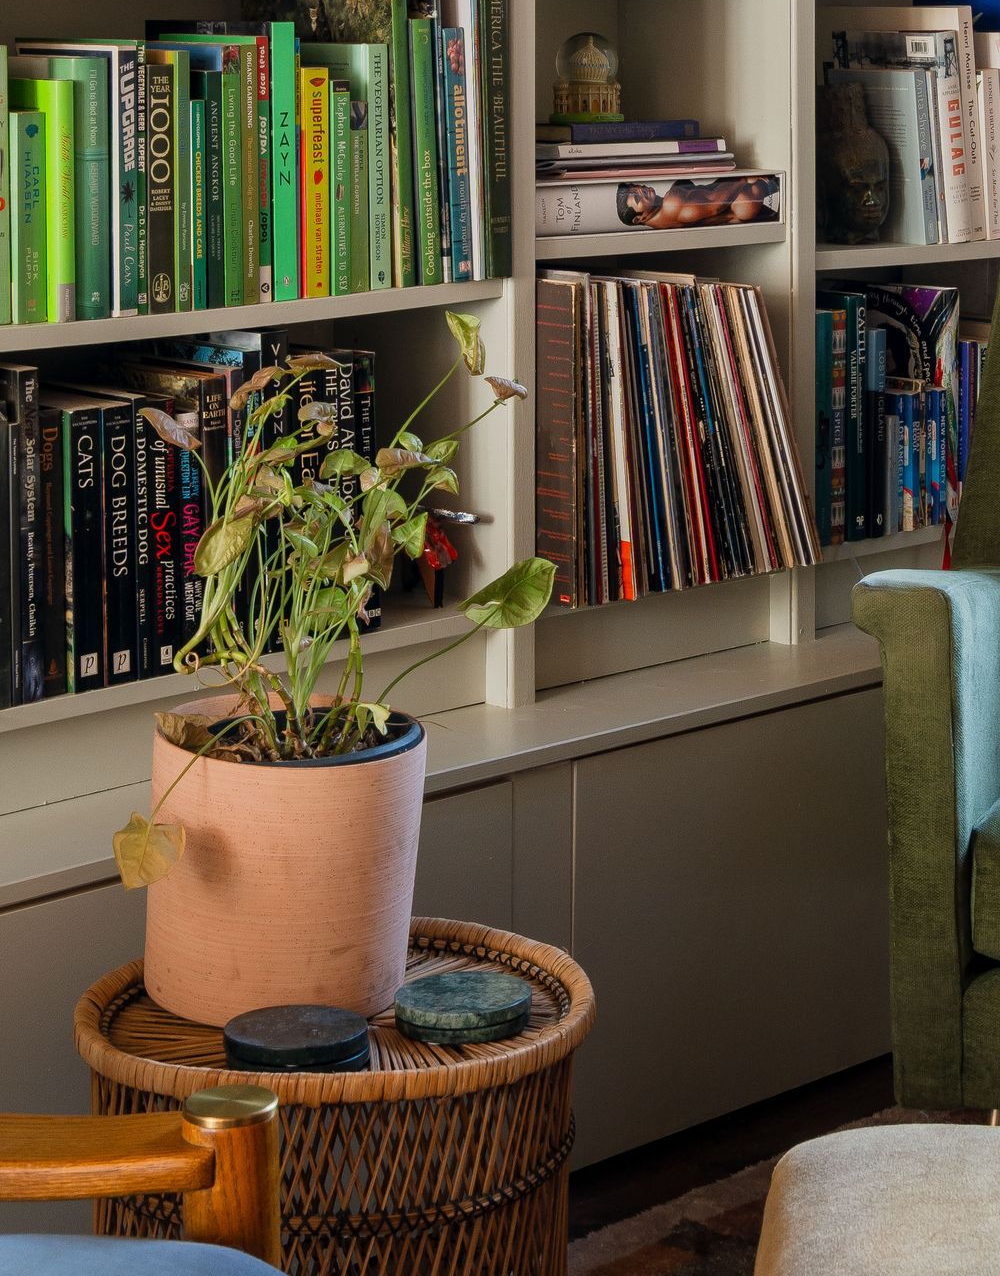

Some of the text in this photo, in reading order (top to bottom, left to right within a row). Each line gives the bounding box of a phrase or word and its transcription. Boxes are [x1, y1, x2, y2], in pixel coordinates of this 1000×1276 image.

[492, 56, 503, 85] THE
[120, 74, 135, 172] UPGRADE
[210, 100, 219, 202] ANCIENT ANGKOR
[279, 112, 291, 186] ZAYN
[310, 91, 324, 163] superfeast
[453, 84, 467, 176] allotment
[494, 91, 505, 182] BEAUTIFUL
[948, 99, 965, 176] GULAG
[24, 152, 32, 223] HIAASEN
[32, 166, 40, 207] CARL
[315, 193, 323, 224] michael
[556, 197, 564, 223] TOM
[571, 186, 582, 232] FINLAND
[124, 224, 134, 286] Paul Carr
[316, 244, 324, 274] straten
[24, 438, 36, 522] Solar System
[39, 427, 58, 471] Dogs
[78, 435, 92, 489] CATS
[111, 435, 127, 577] DOG BREEDS
[136, 438, 149, 565] DOMESTIC DOG
[150, 440, 176, 620] of unusual Sex practices
[183, 503, 199, 536] GAY
